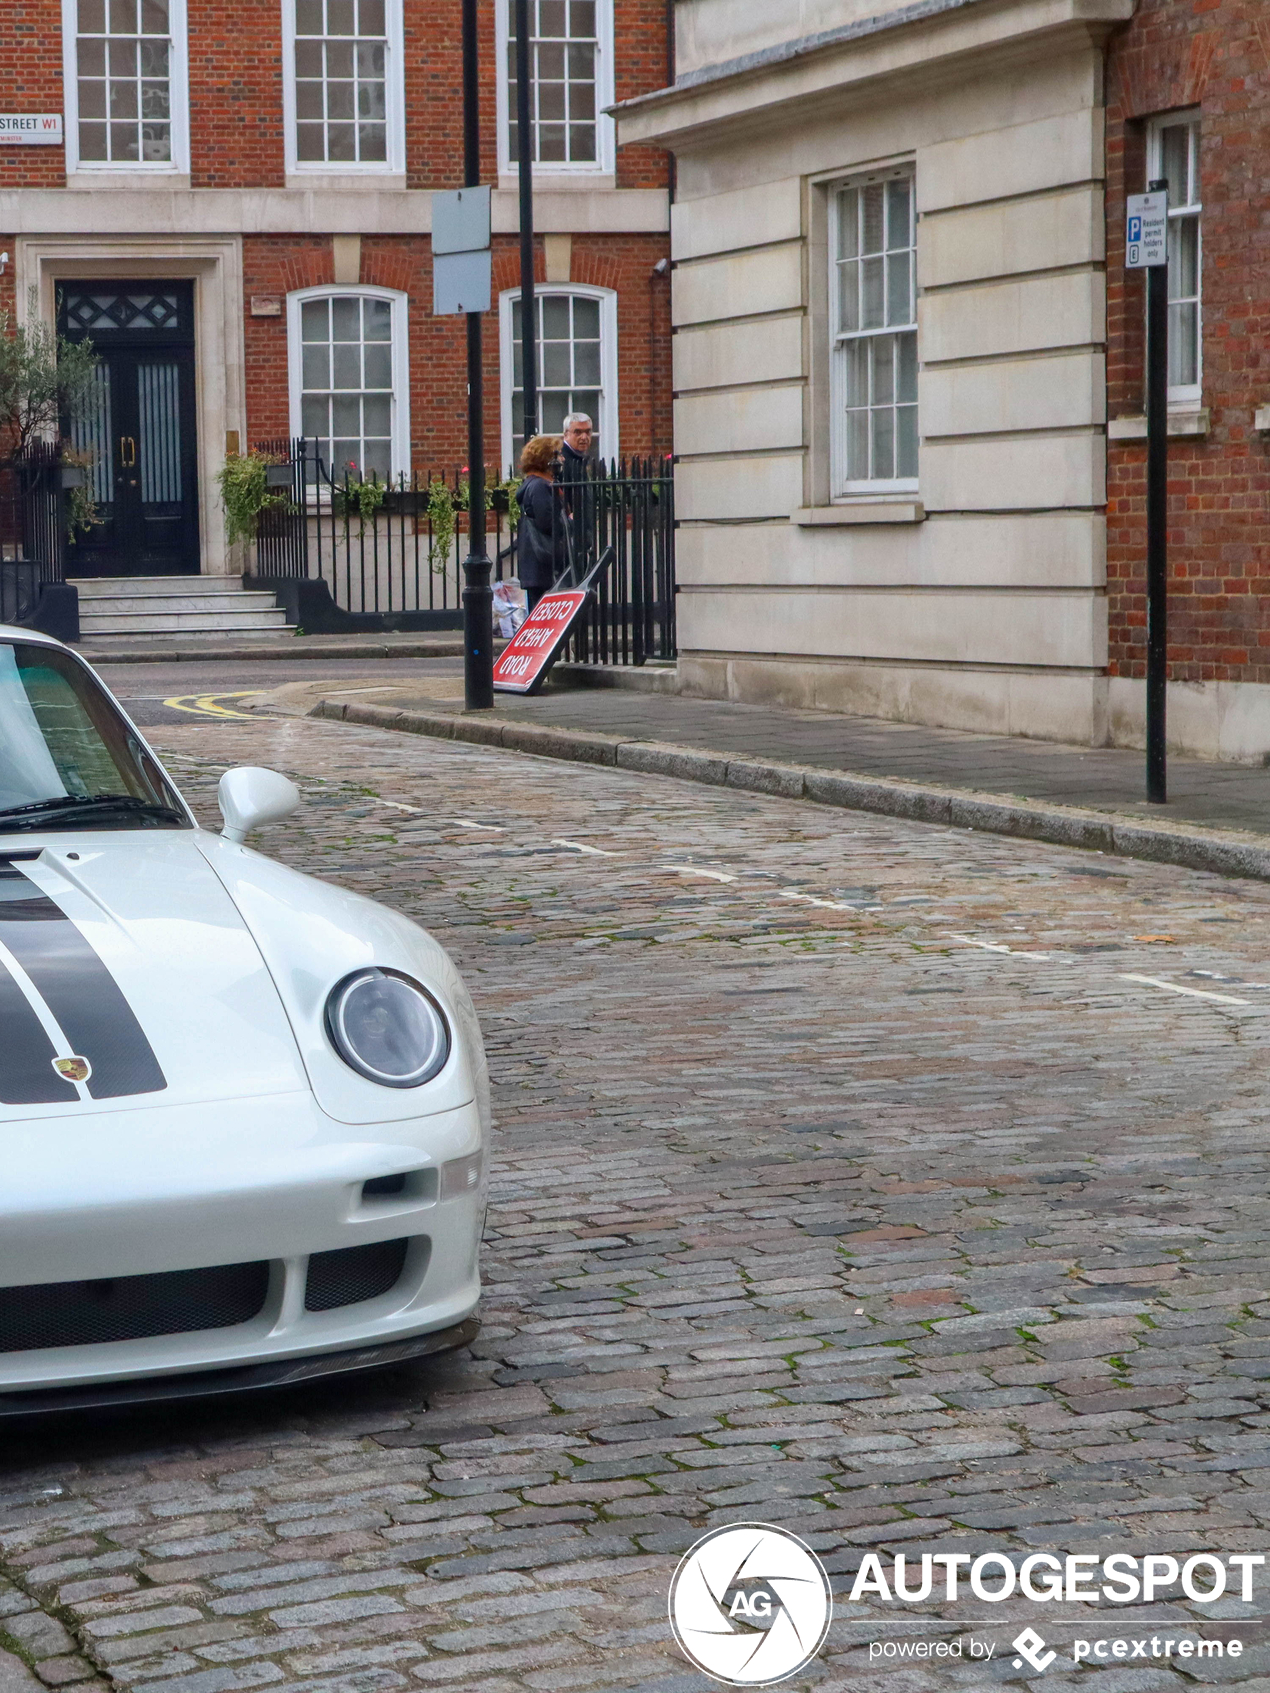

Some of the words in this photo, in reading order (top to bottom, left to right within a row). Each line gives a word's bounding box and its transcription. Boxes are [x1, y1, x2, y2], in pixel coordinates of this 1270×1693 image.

[0, 118, 38, 129] STREET
[42, 118, 57, 129] W1
[1142, 218, 1164, 228] Resident
[1131, 218, 1140, 240] P
[1145, 229, 1162, 238] permit
[1144, 240, 1162, 248] holders
[1132, 250, 1136, 260] E
[1148, 250, 1158, 258] only
[531, 600, 574, 622] CLOSED
[514, 628, 554, 648] AHEAD
[499, 655, 533, 676] ROAD
